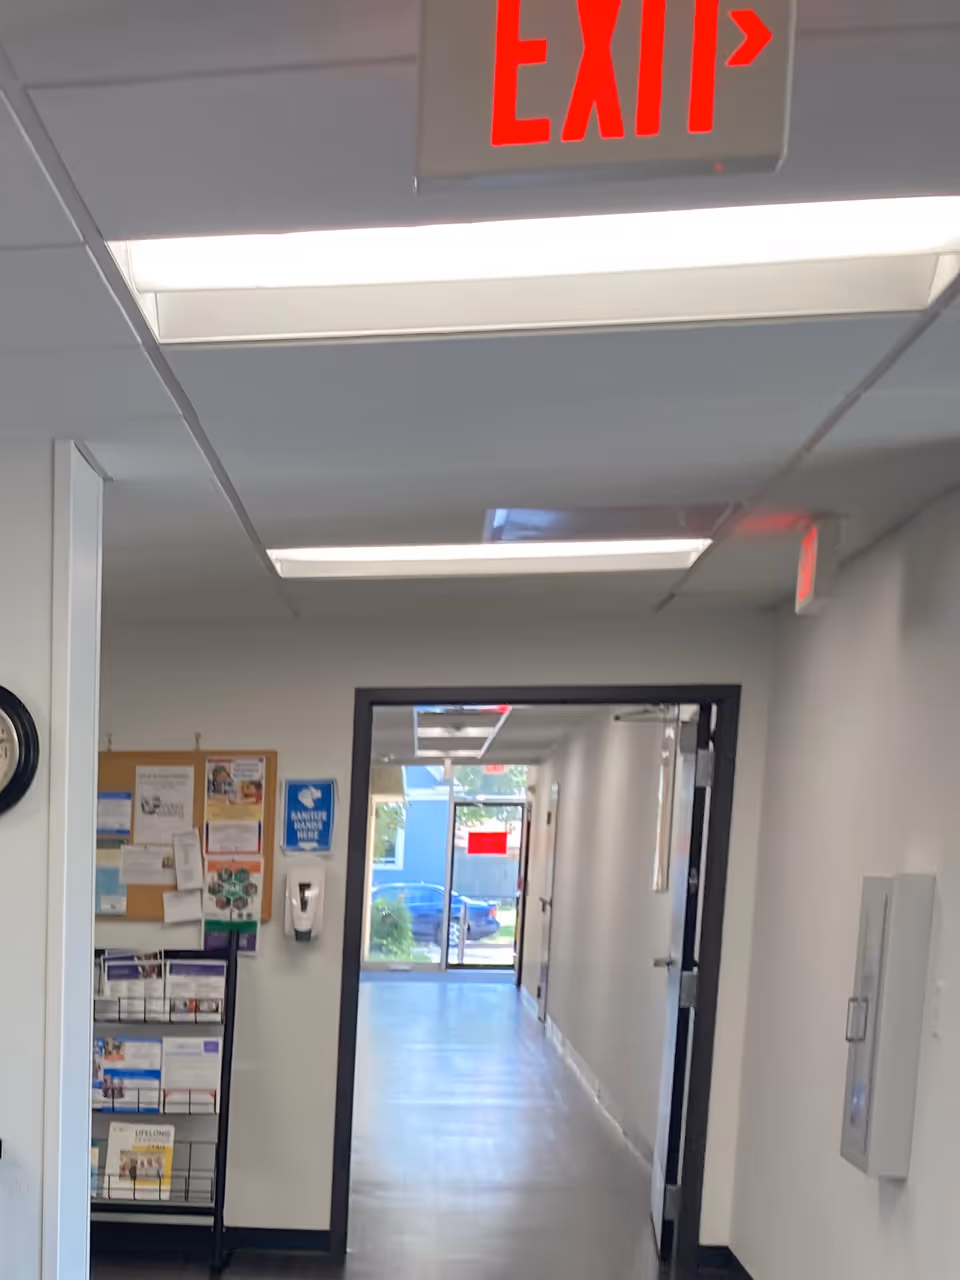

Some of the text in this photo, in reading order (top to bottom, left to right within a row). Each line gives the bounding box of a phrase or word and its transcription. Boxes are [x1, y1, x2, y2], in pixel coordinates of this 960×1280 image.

[291, 811, 327, 821] SANITIZE
[294, 821, 323, 830] HANDS
[297, 831, 319, 840] HERE
[135, 1129, 170, 1137] LIFELONG
